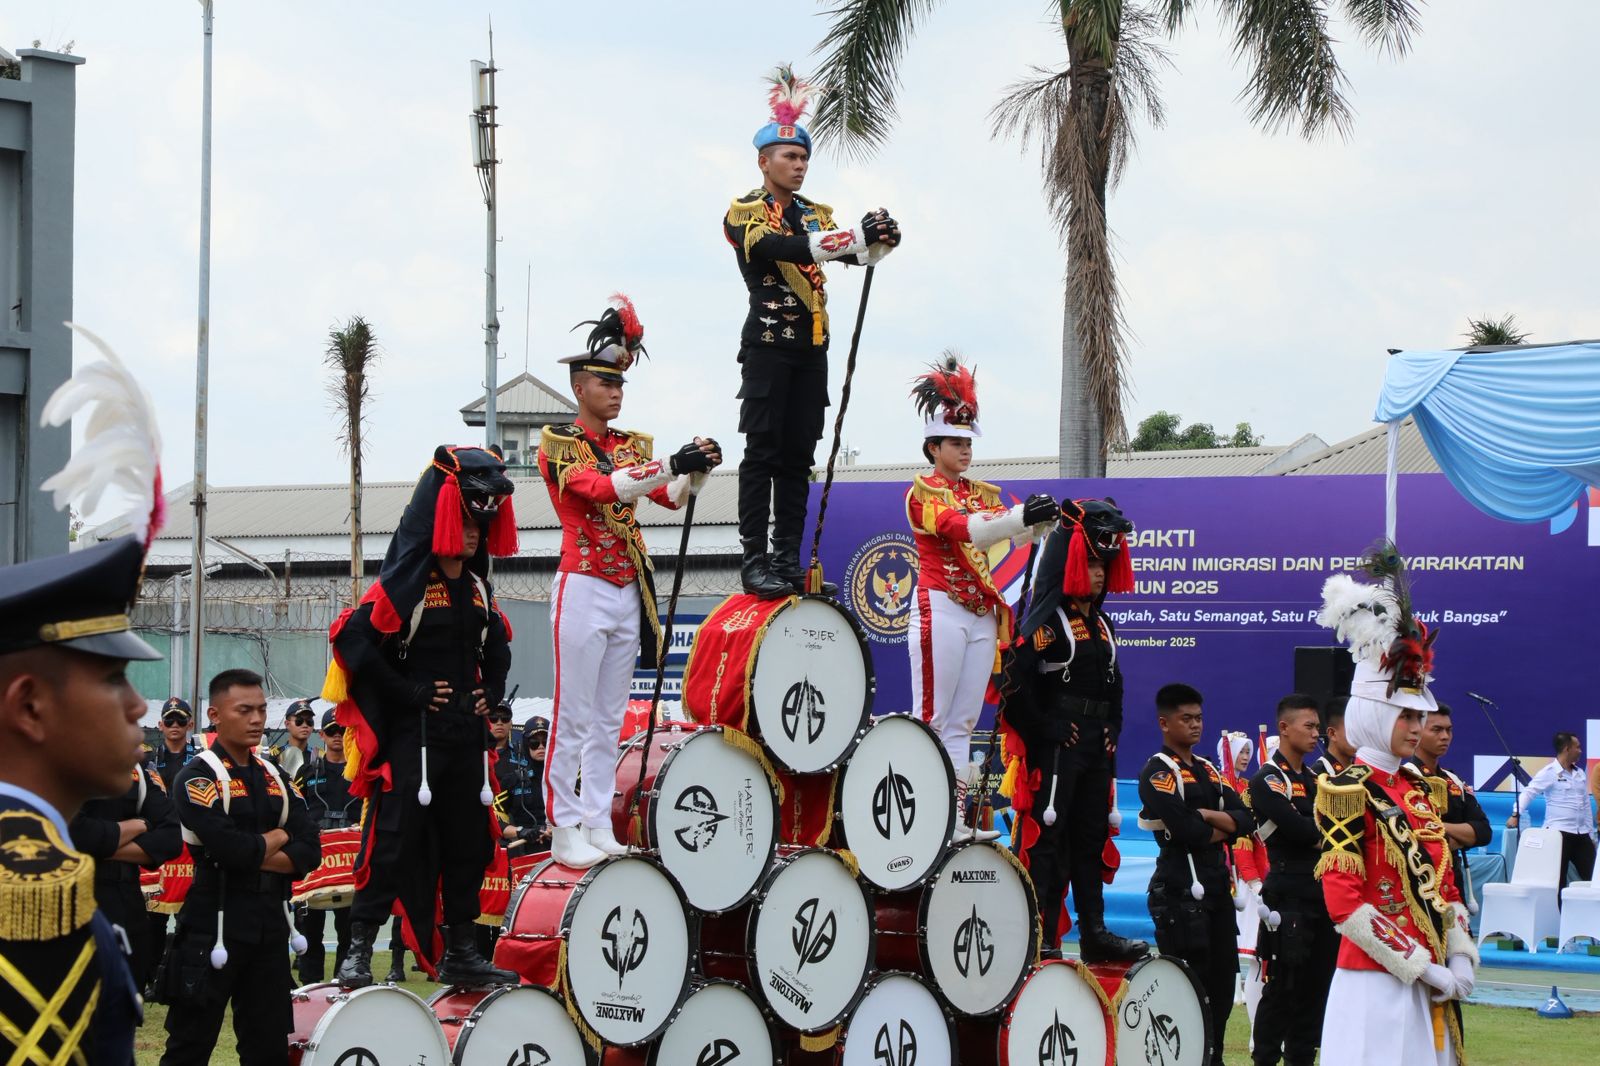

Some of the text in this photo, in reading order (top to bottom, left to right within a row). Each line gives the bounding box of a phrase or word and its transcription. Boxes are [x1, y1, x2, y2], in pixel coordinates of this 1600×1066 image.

[1192, 557, 1276, 572] IMIGRASI
[1282, 557, 1324, 571] DAN
[843, 533, 912, 611] KEMENTERIAN IMIGRASI DAN
[1171, 580, 1219, 594] 2025
[1159, 609, 1191, 622] Satu
[1193, 609, 1268, 625] Semangat,
[1271, 609, 1304, 622] Satu
[888, 636, 909, 644] INDO
[1115, 636, 1196, 647] November 2025
[744, 778, 754, 857] HARRIER
[889, 858, 911, 870] EVANS
[951, 870, 998, 884] MAXTONE
[770, 972, 813, 1014] MAXTONE
[1547, 998, 1559, 1011] 7
[595, 1002, 645, 1023] MAXTONE
